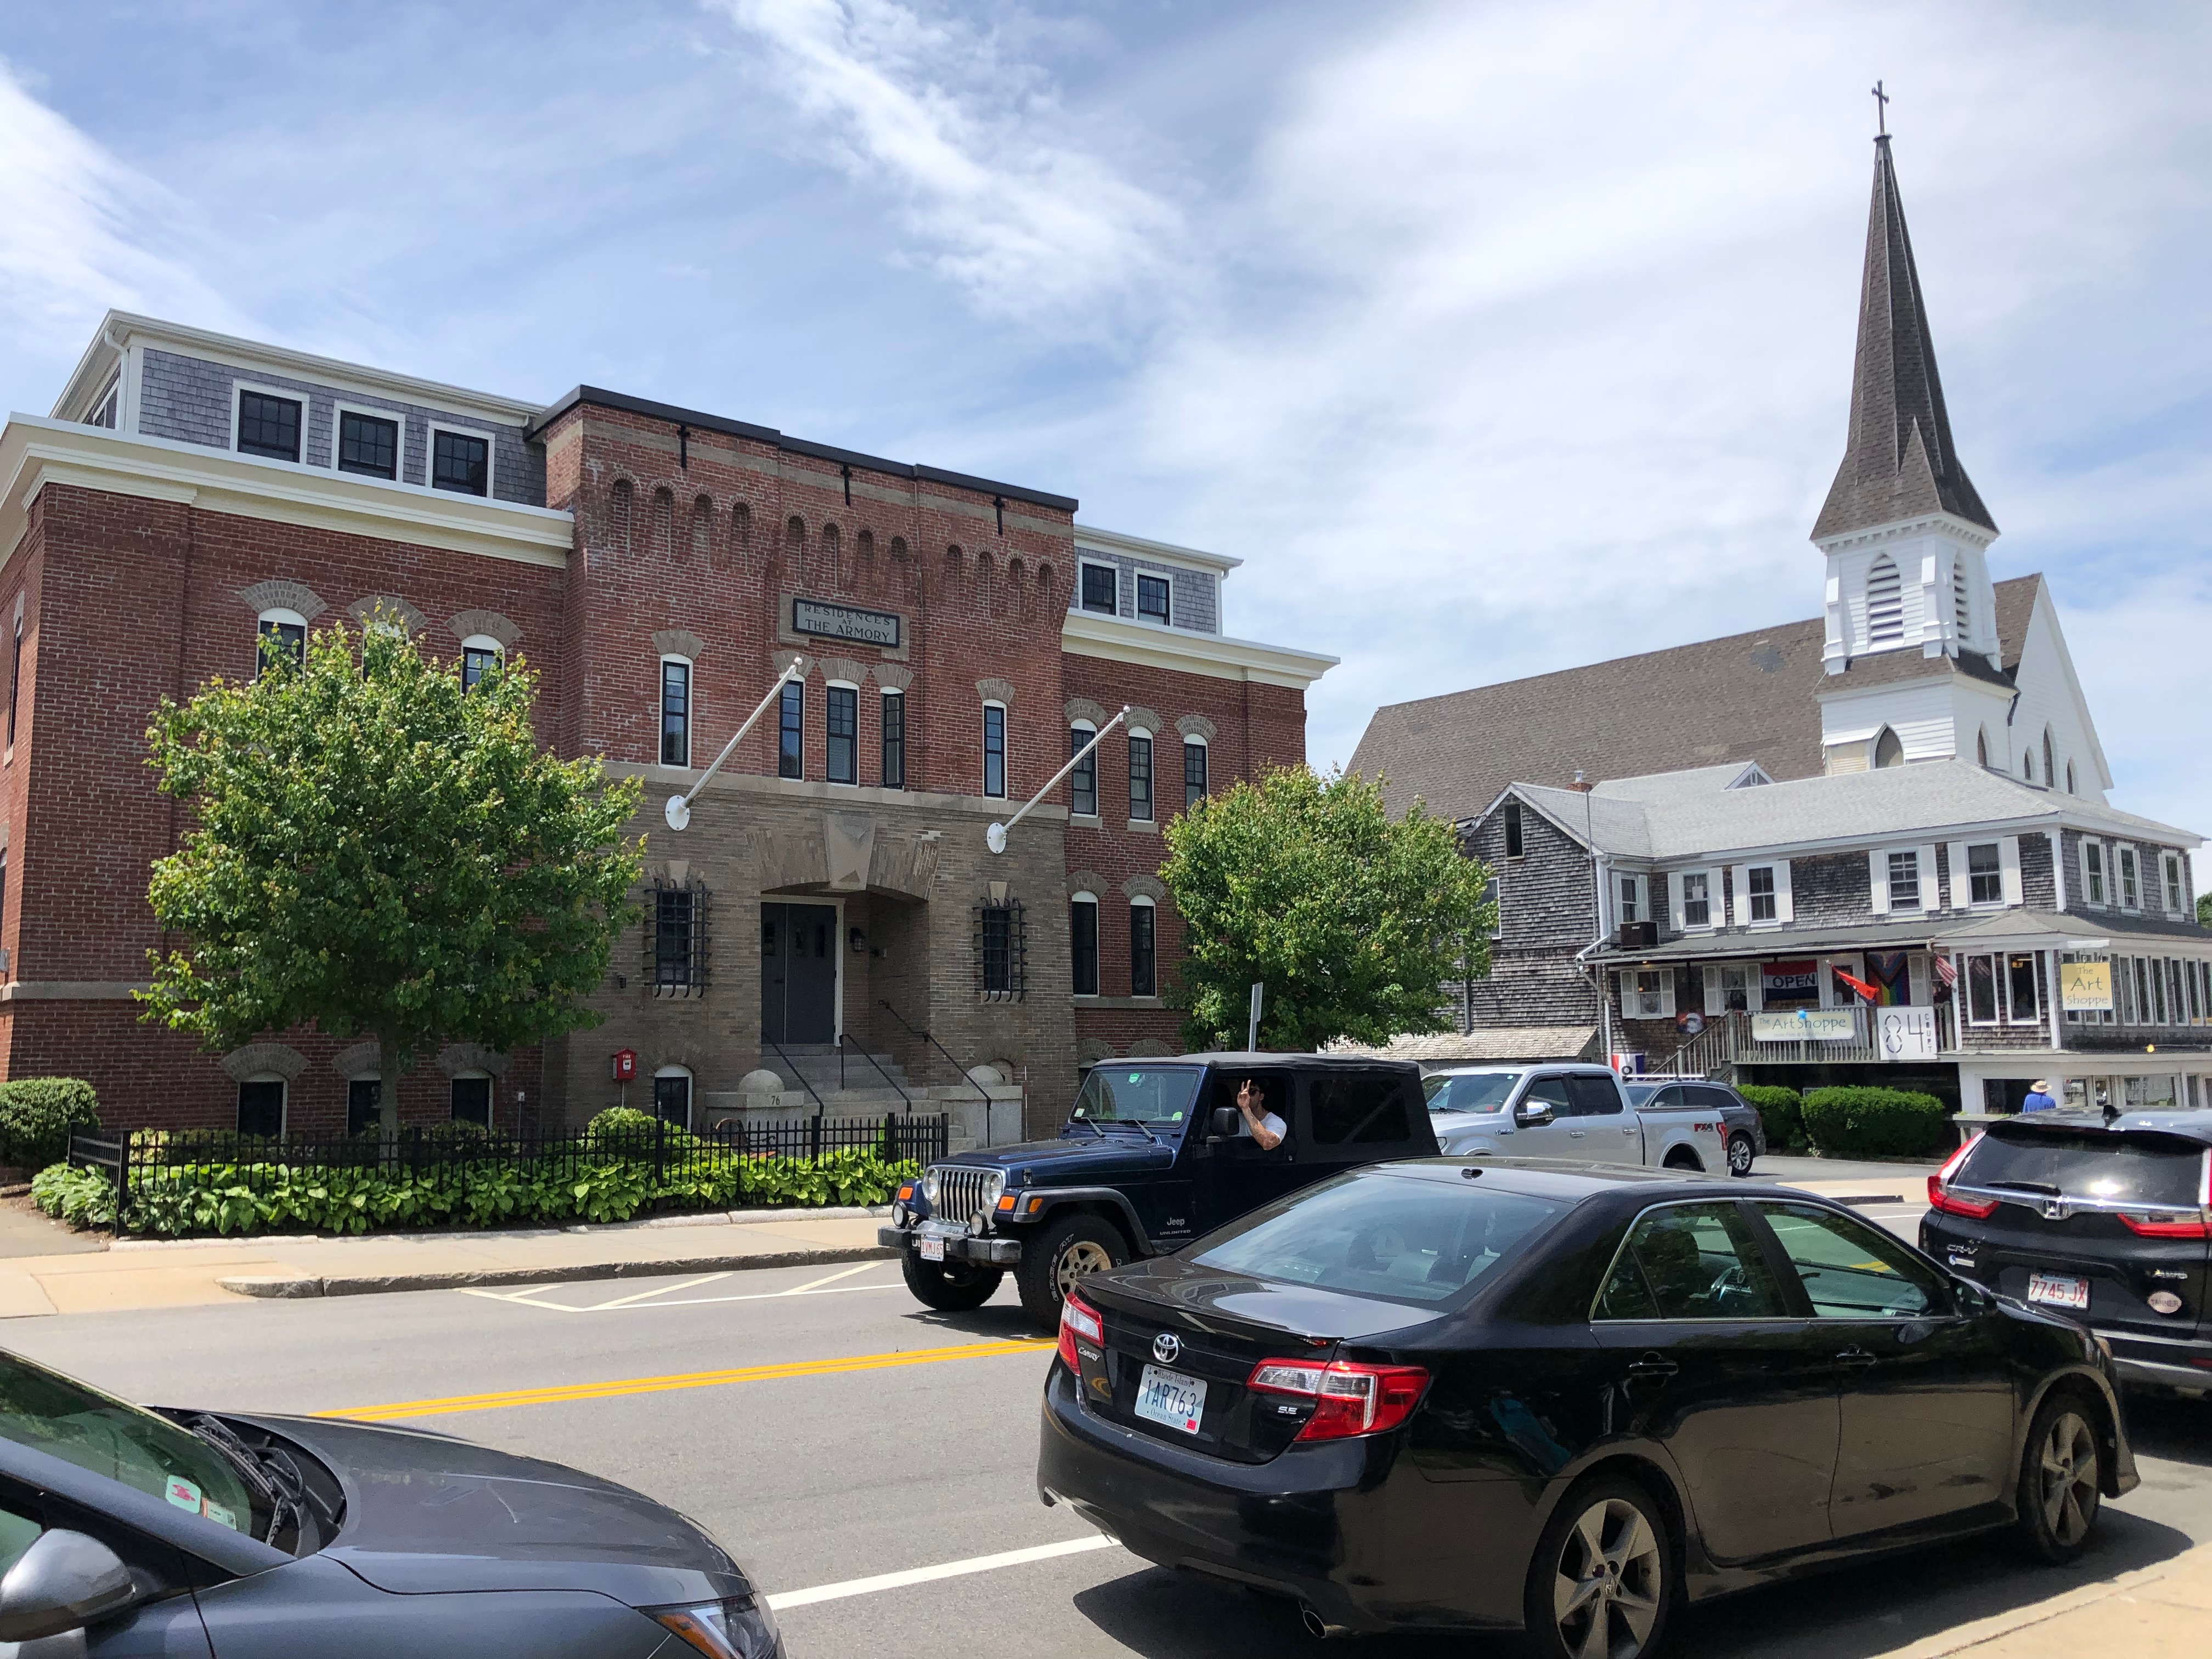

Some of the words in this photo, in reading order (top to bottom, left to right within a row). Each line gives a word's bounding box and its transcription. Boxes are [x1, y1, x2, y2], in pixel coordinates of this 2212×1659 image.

[805, 605, 890, 626] RESIDENCES
[805, 619, 830, 632] THE
[836, 624, 890, 642] ARMORY
[2076, 966, 2094, 974] The
[1773, 974, 1816, 988] OPEN
[2070, 977, 2103, 991] Art
[2067, 994, 2108, 1007] Shoppe
[1772, 1018, 1795, 1029] Art
[1798, 1018, 1847, 1031] Shoppe
[1884, 1014, 1925, 1053] 84
[771, 1095, 780, 1105] 76
[1694, 1123, 1714, 1132] FX4
[1166, 1217, 1185, 1227] Jeep
[1947, 1244, 1978, 1255] CR-V
[2031, 1280, 2065, 1300] 7745
[1158, 1369, 1173, 1381] Rhode
[1175, 1374, 1192, 1387] Island
[1145, 1379, 1197, 1418] 1AR763
[1150, 1408, 1166, 1421] Ocean
[1169, 1414, 1182, 1425] State
[1278, 1406, 1298, 1415] SE
